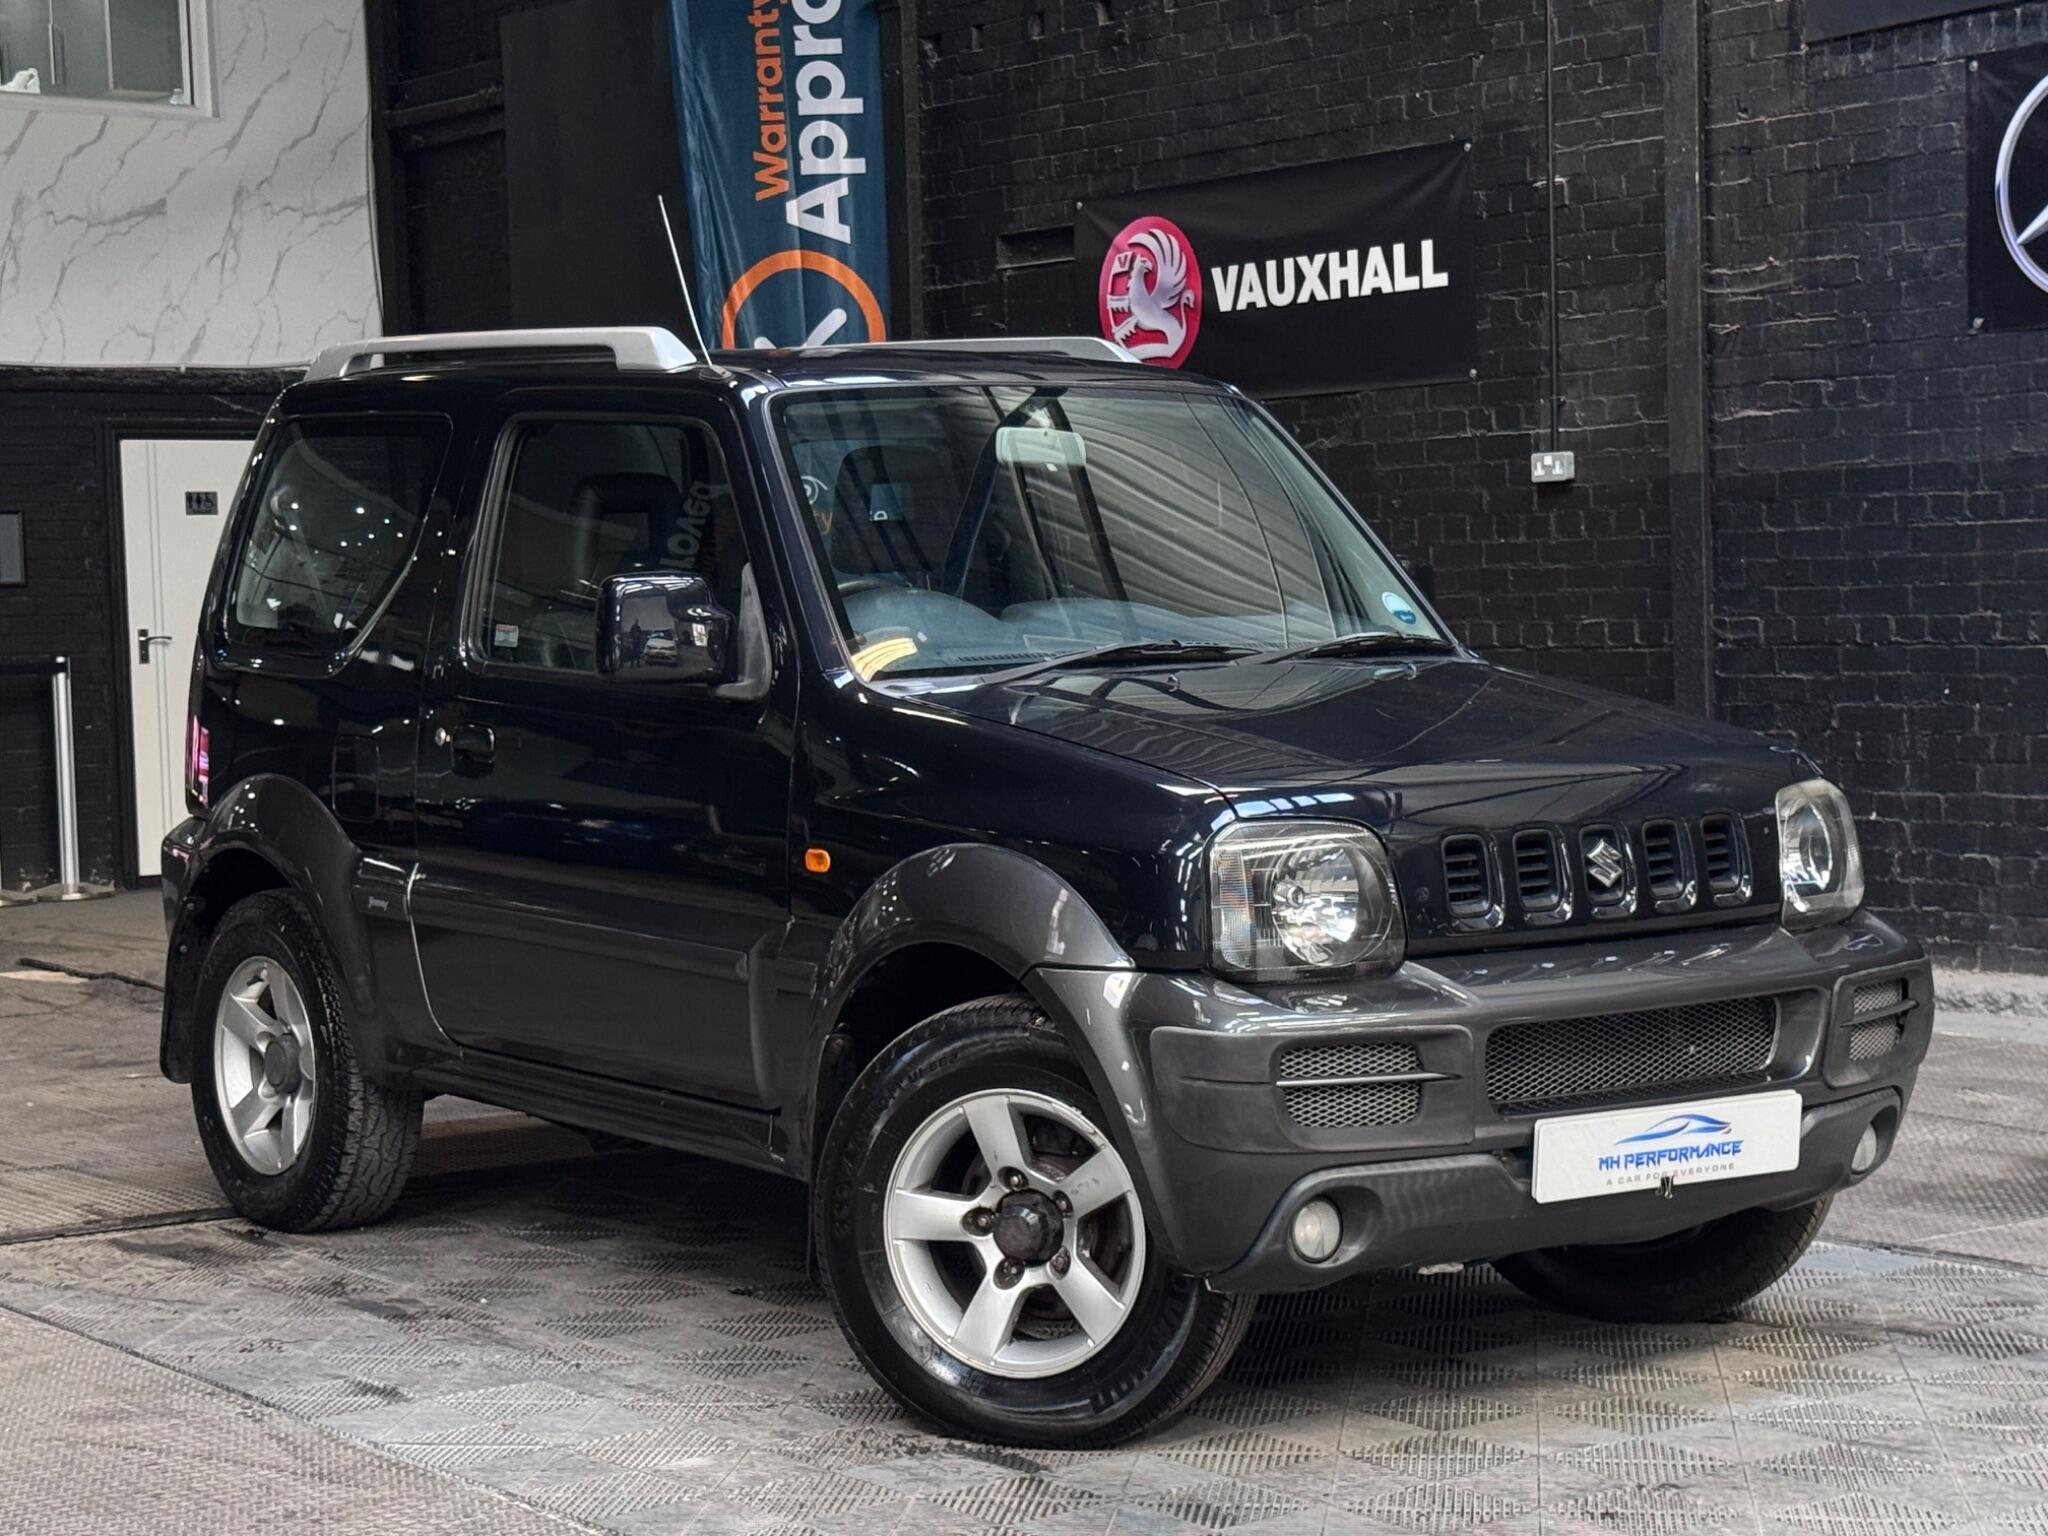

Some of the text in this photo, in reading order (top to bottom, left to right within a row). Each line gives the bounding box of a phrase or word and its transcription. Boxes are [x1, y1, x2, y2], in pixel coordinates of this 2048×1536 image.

[1211, 239, 1449, 312] VAUXHALL
[1598, 1140, 1744, 1171] MH PERFORMANCE
[1606, 1178, 1613, 1186] A
[1618, 1175, 1641, 1185] CAR
